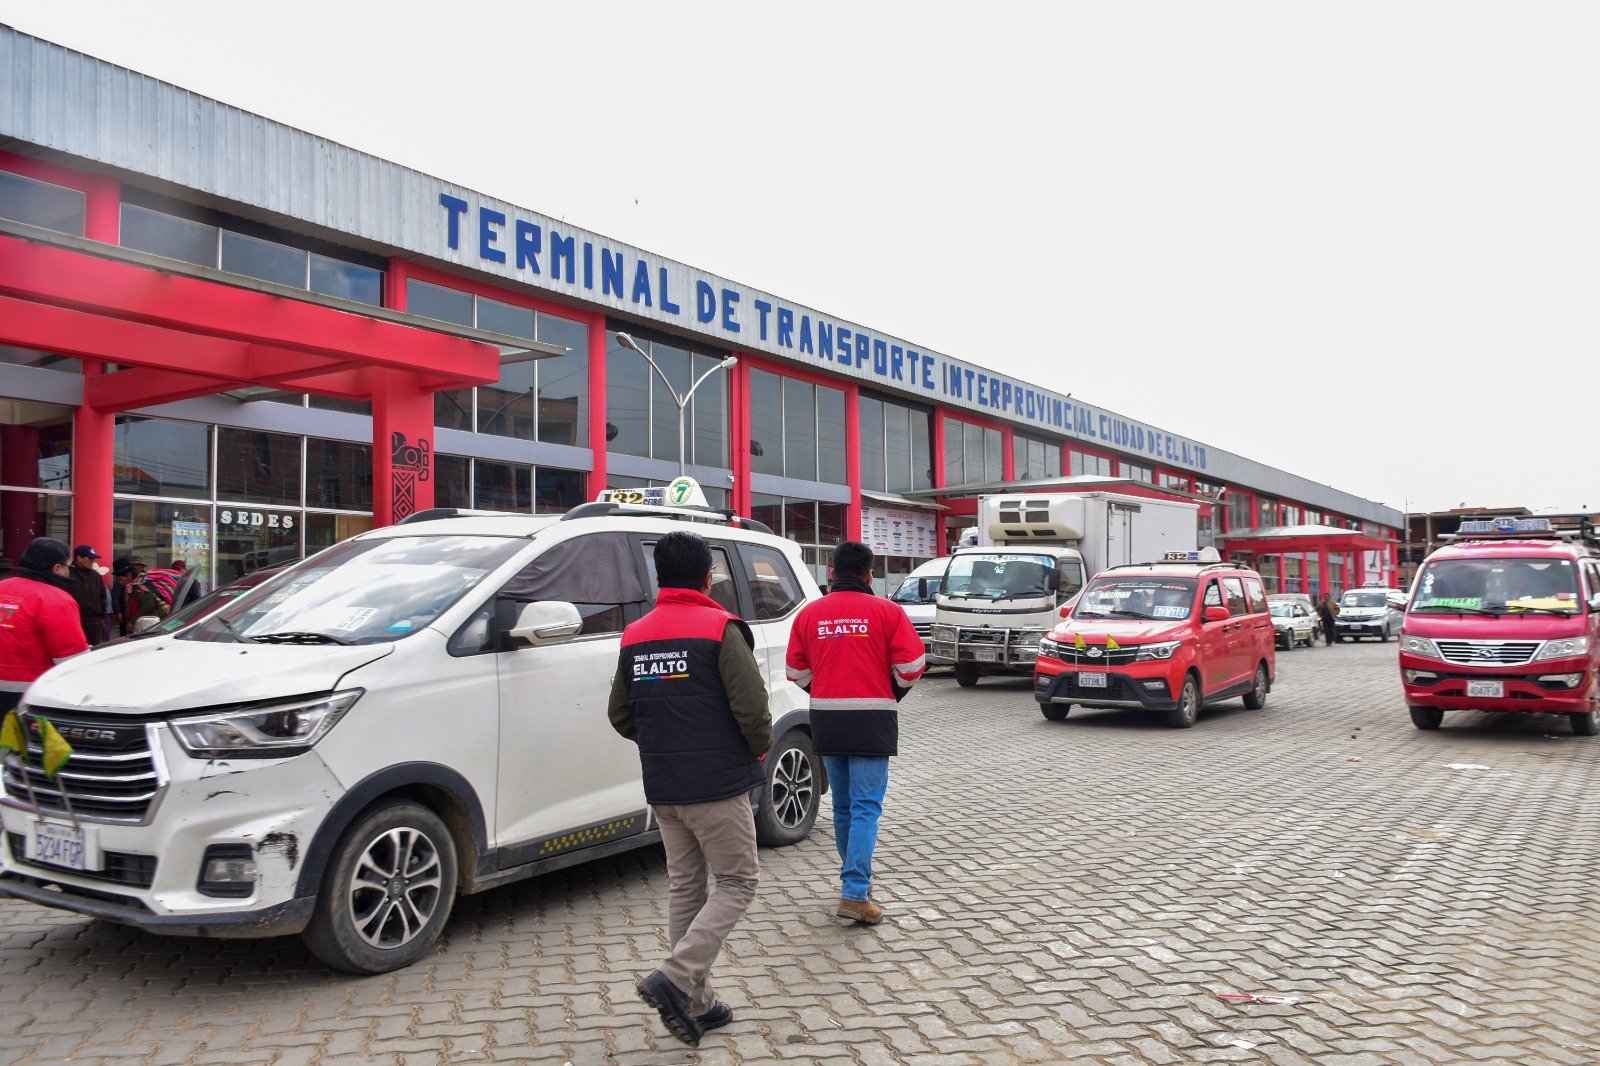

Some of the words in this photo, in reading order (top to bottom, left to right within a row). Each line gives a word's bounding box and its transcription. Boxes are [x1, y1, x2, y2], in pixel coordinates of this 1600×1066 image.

[439, 193, 680, 315] TERMINAL
[697, 279, 740, 332] DE
[755, 299, 935, 390] TRANSPORTE
[943, 361, 1096, 437] INTERPROVINCIAL
[1099, 414, 1144, 450] CIUDAD
[1148, 430, 1162, 456] DE
[1166, 435, 1179, 461] EL
[1181, 441, 1207, 469] ALTO
[604, 492, 643, 504] 132
[676, 486, 687, 503] 7
[221, 510, 294, 529] SEDES
[818, 626, 833, 635] EL
[835, 624, 867, 634] ALTO
[634, 663, 648, 675] EL
[650, 659, 687, 674] ALTO
